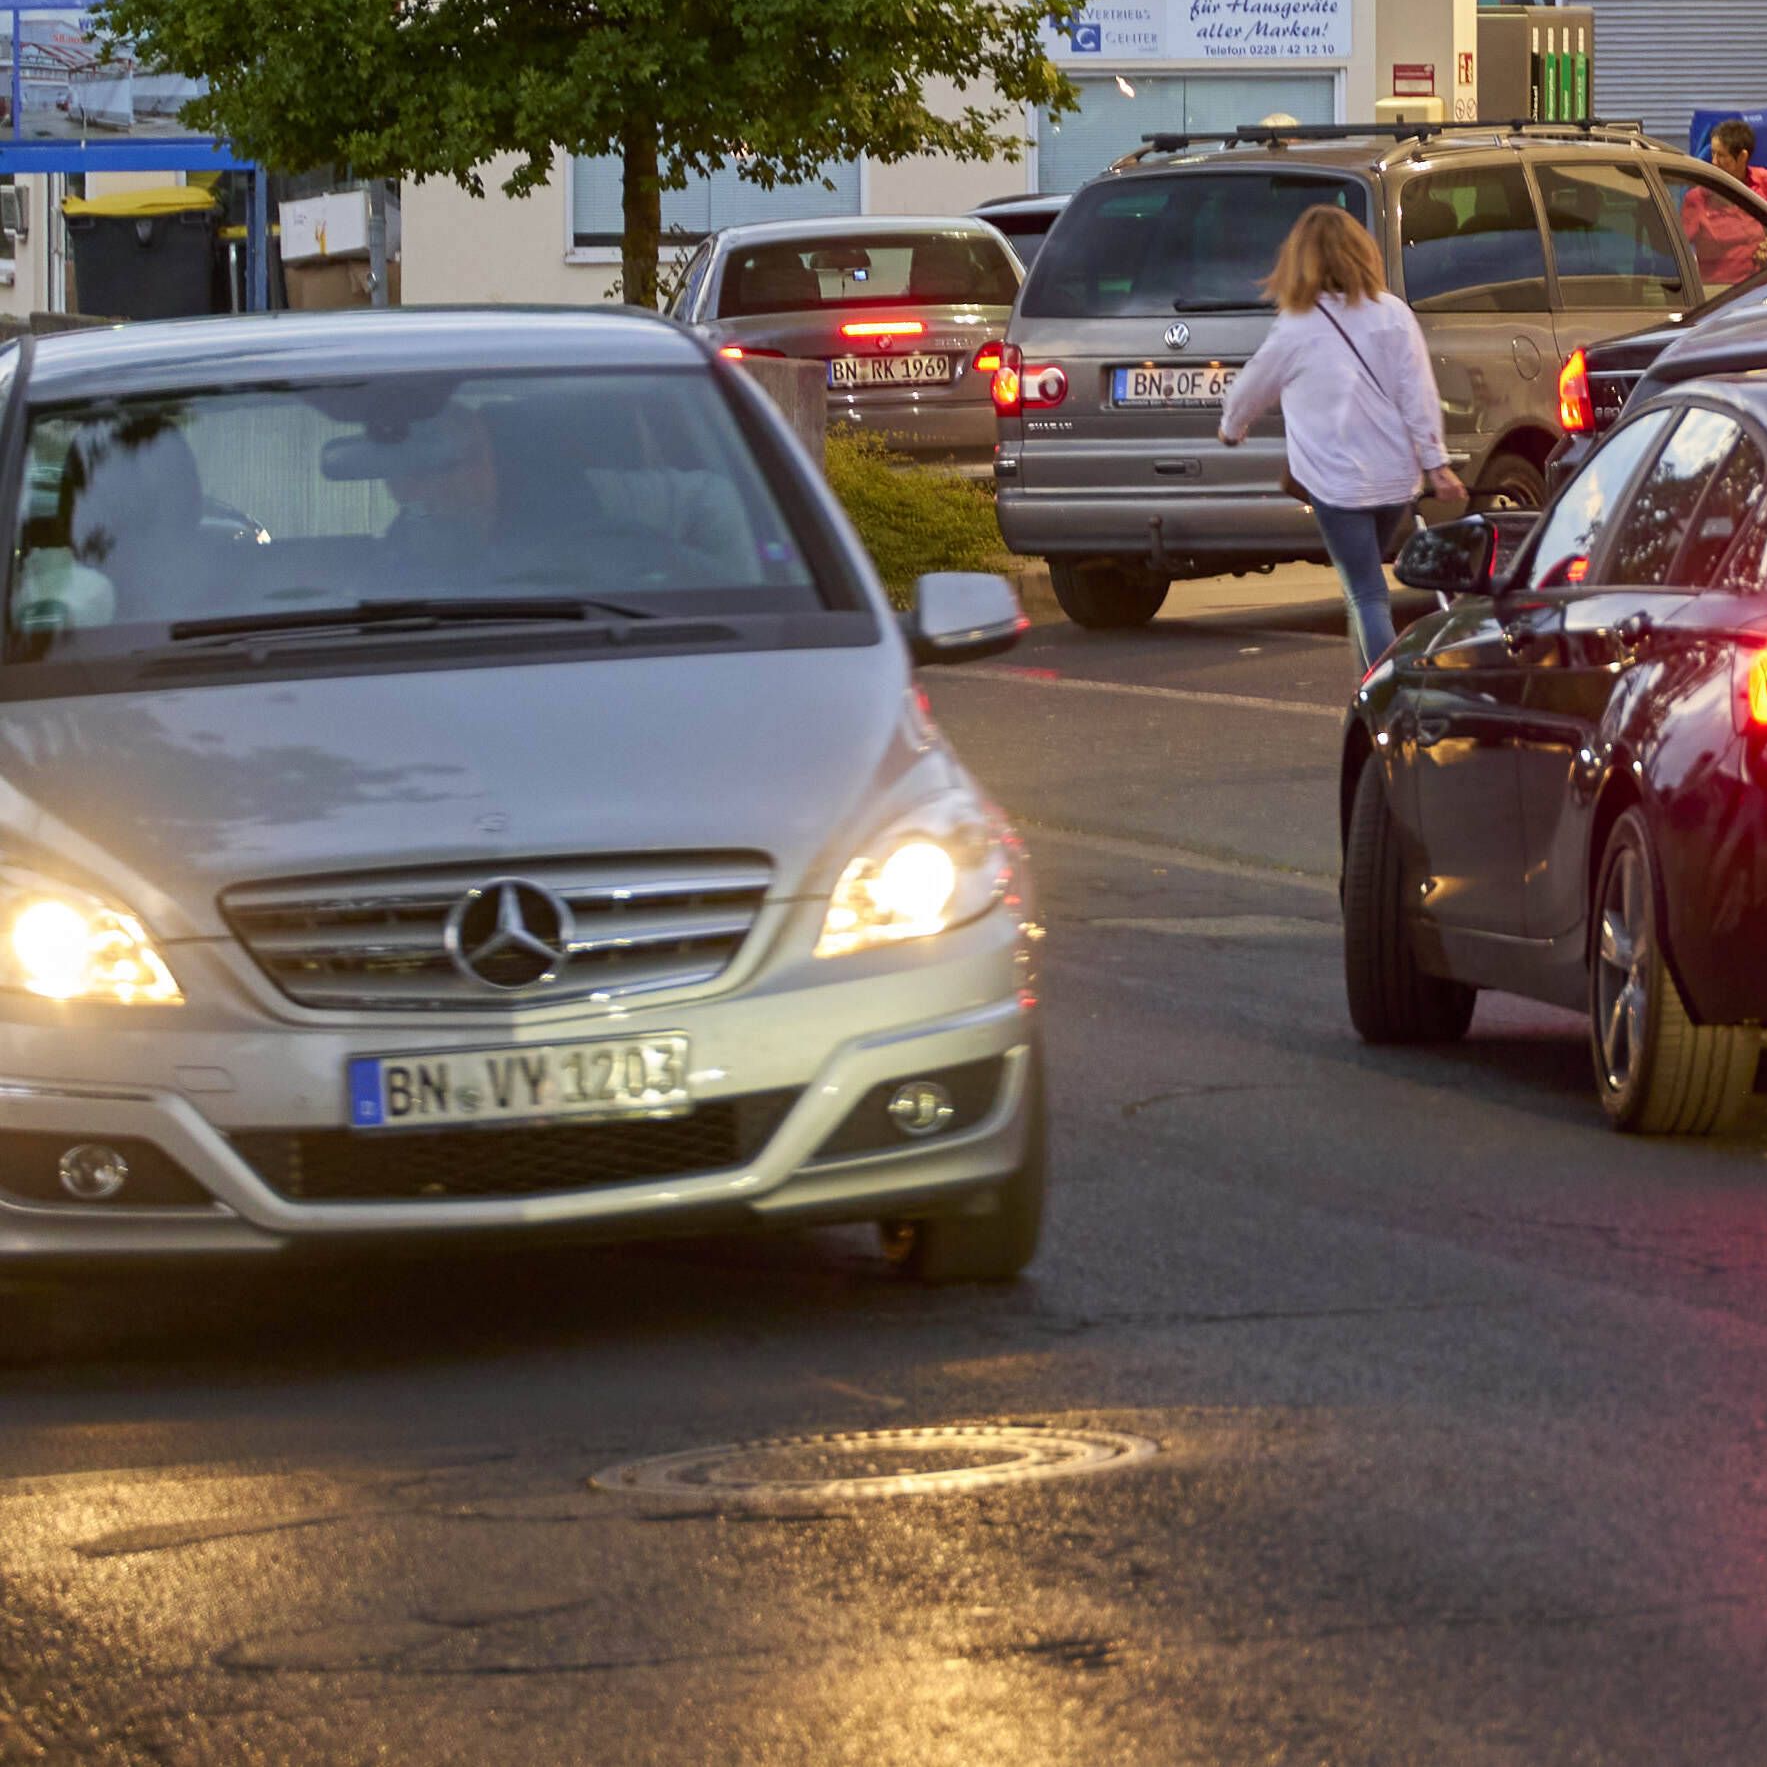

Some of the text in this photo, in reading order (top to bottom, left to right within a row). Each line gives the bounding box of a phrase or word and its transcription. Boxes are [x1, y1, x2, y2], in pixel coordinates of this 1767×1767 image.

[1196, 20, 1328, 41] aller Marken!
[1204, 45, 1246, 56] Telefon
[1250, 45, 1277, 55] 0228
[1287, 45, 1301, 55] 42
[1305, 45, 1319, 55] 12
[1322, 44, 1335, 54] 10
[833, 355, 948, 381] BN RK 1969
[1134, 371, 1162, 396] BN
[385, 1062, 448, 1117] BN
[486, 1054, 545, 1108] VY
